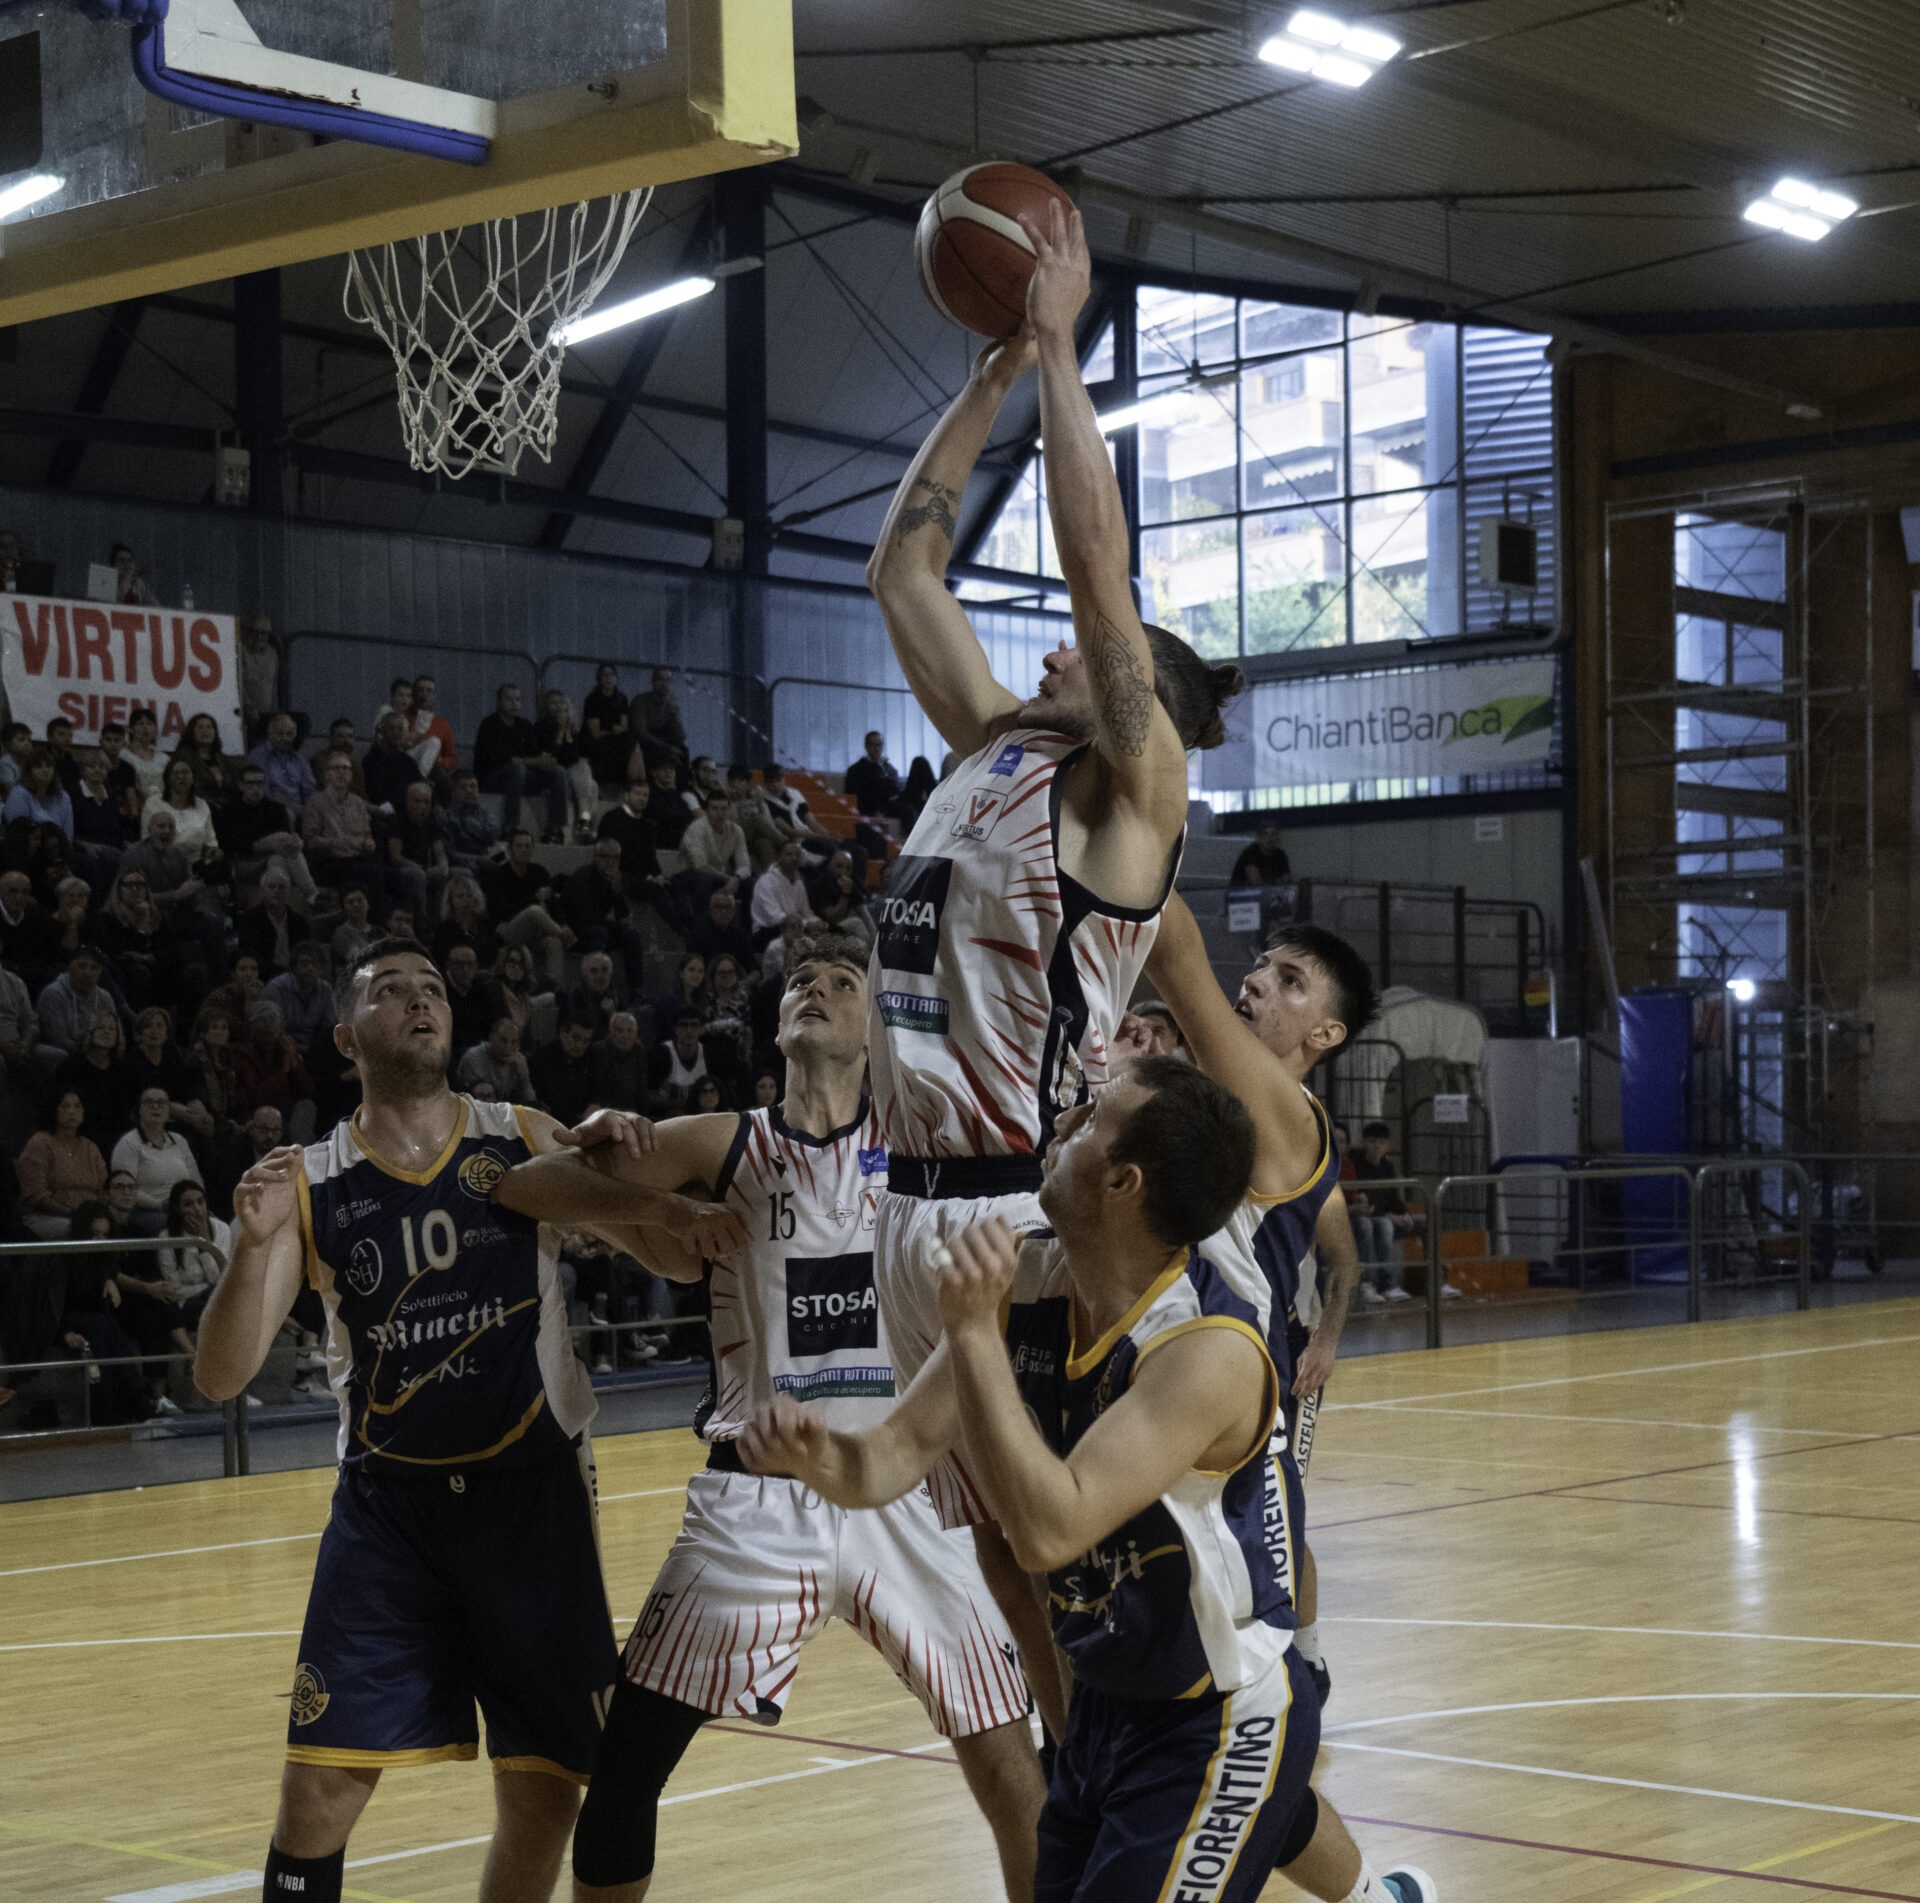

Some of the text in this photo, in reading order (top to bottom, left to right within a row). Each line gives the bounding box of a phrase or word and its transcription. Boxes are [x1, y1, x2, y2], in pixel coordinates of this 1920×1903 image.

[12, 601, 223, 693] VIRTUS
[1266, 705, 1502, 752] ChiantiBanca
[880, 897, 937, 930] TOSA
[768, 1190, 796, 1242] 15
[401, 1208, 458, 1277] 10
[791, 1286, 877, 1318] STOSA
[803, 1316, 868, 1333] CUCINE
[775, 1368, 894, 1390] PIANIGIANI ROTTAMI
[637, 1590, 675, 1639] 15
[302, 1699, 324, 1721] ABC
[1174, 1716, 1275, 1903] FIORENTINO
[283, 1874, 305, 1892] NBA
